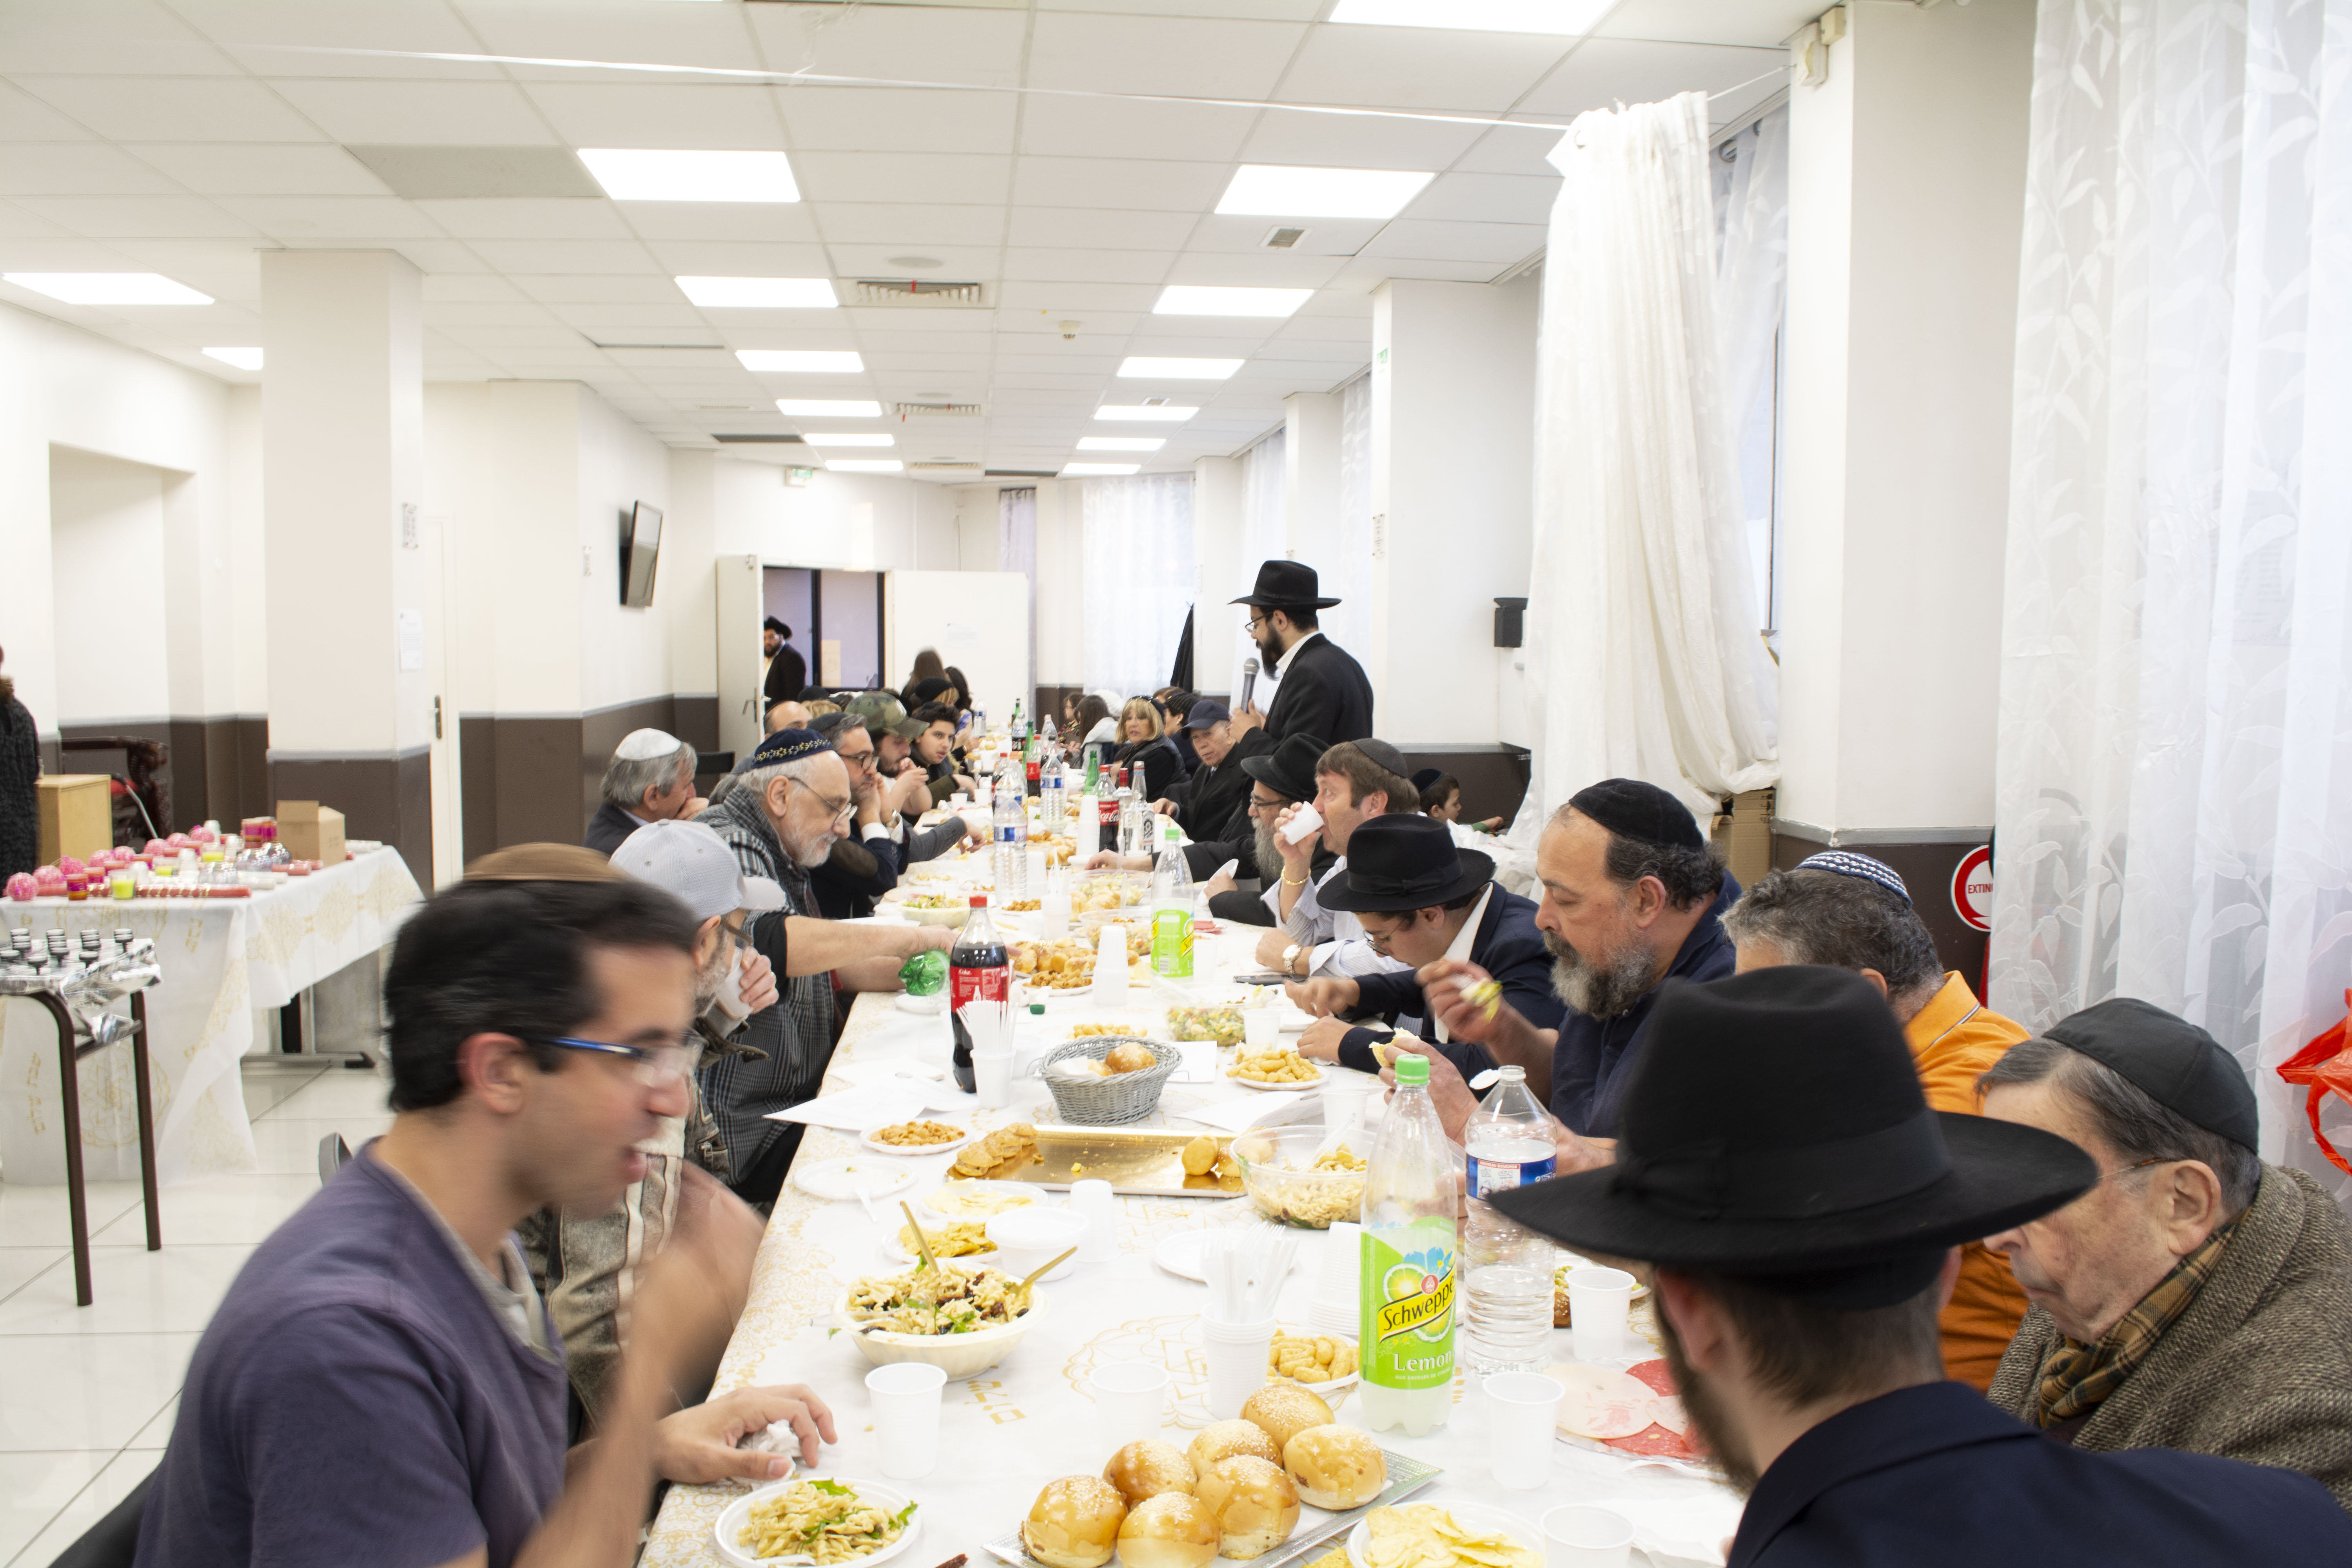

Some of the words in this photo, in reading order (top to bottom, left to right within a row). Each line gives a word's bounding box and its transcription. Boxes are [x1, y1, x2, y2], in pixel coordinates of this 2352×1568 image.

[1968, 883, 1993, 894] EXTIN
[1383, 1275, 1455, 1331] Schweppe
[1394, 1350, 1452, 1371] Lemon
